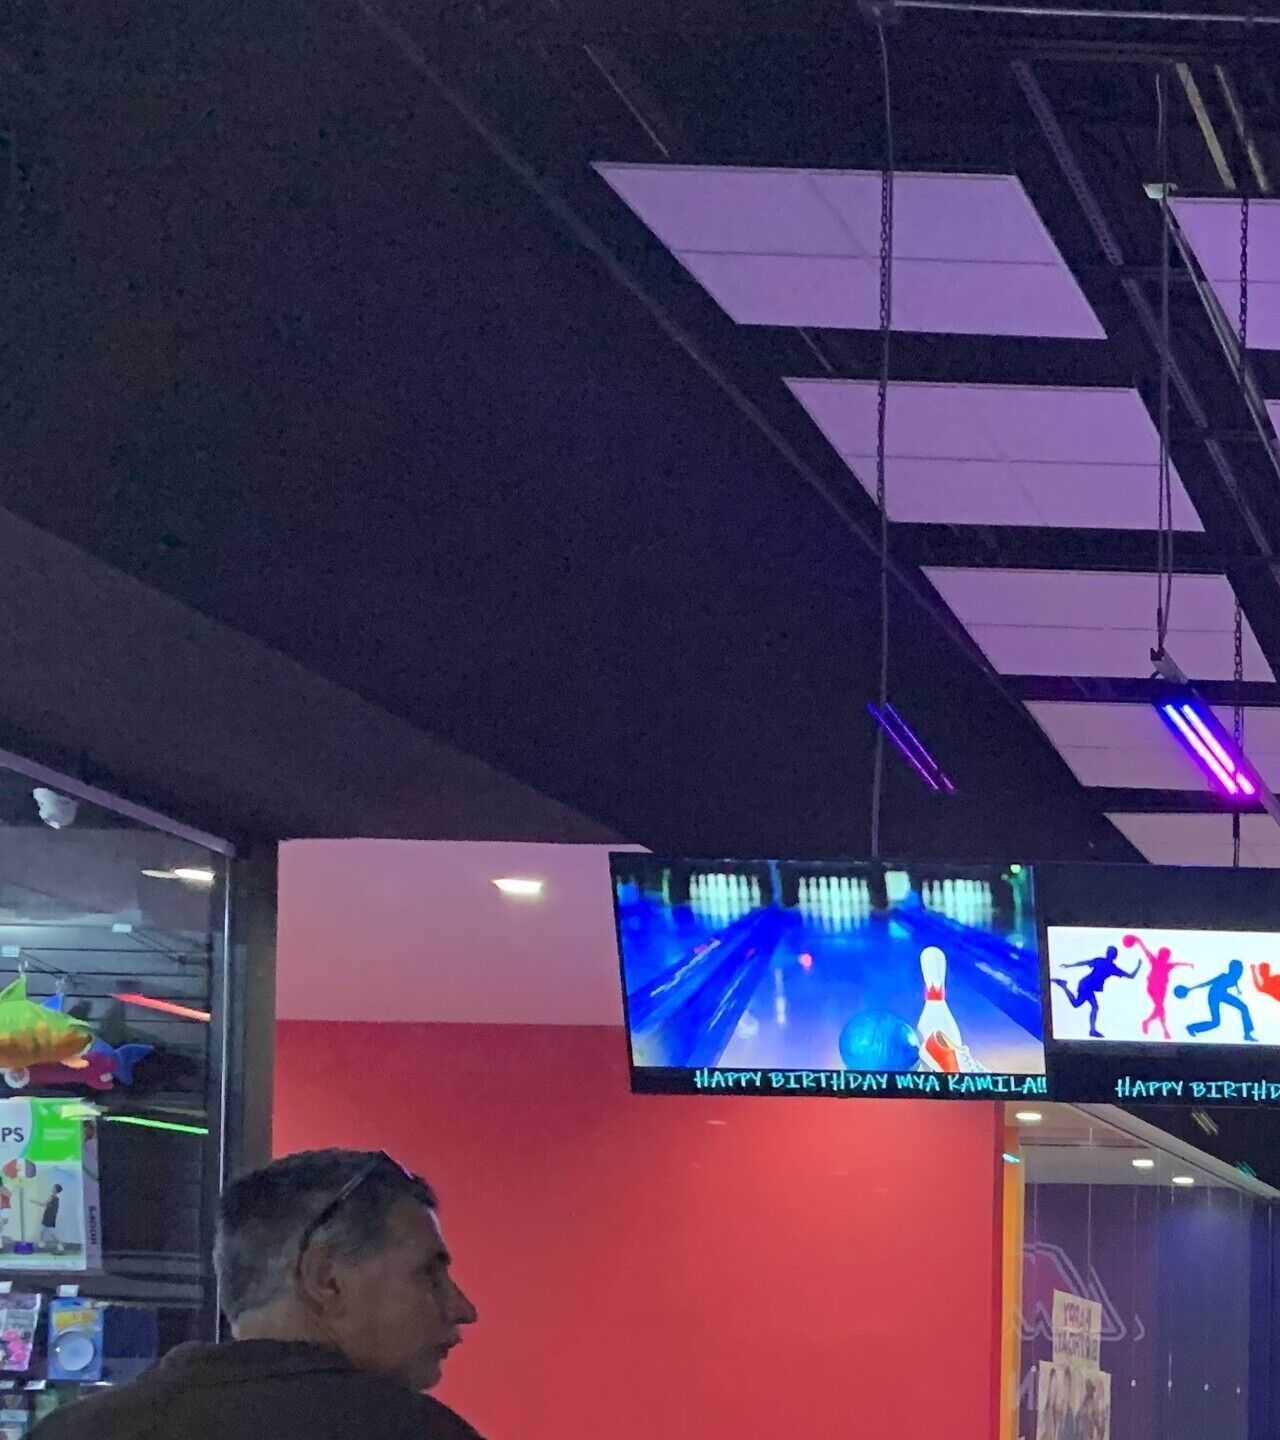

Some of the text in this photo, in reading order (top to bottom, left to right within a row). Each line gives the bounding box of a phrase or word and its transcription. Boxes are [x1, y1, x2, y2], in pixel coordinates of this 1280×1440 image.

[695, 1068, 761, 1088] HAPPY
[768, 1070, 888, 1091] BIRTHDAY
[896, 1074, 940, 1092] MYA
[1115, 1077, 1183, 1098] HAPPY
